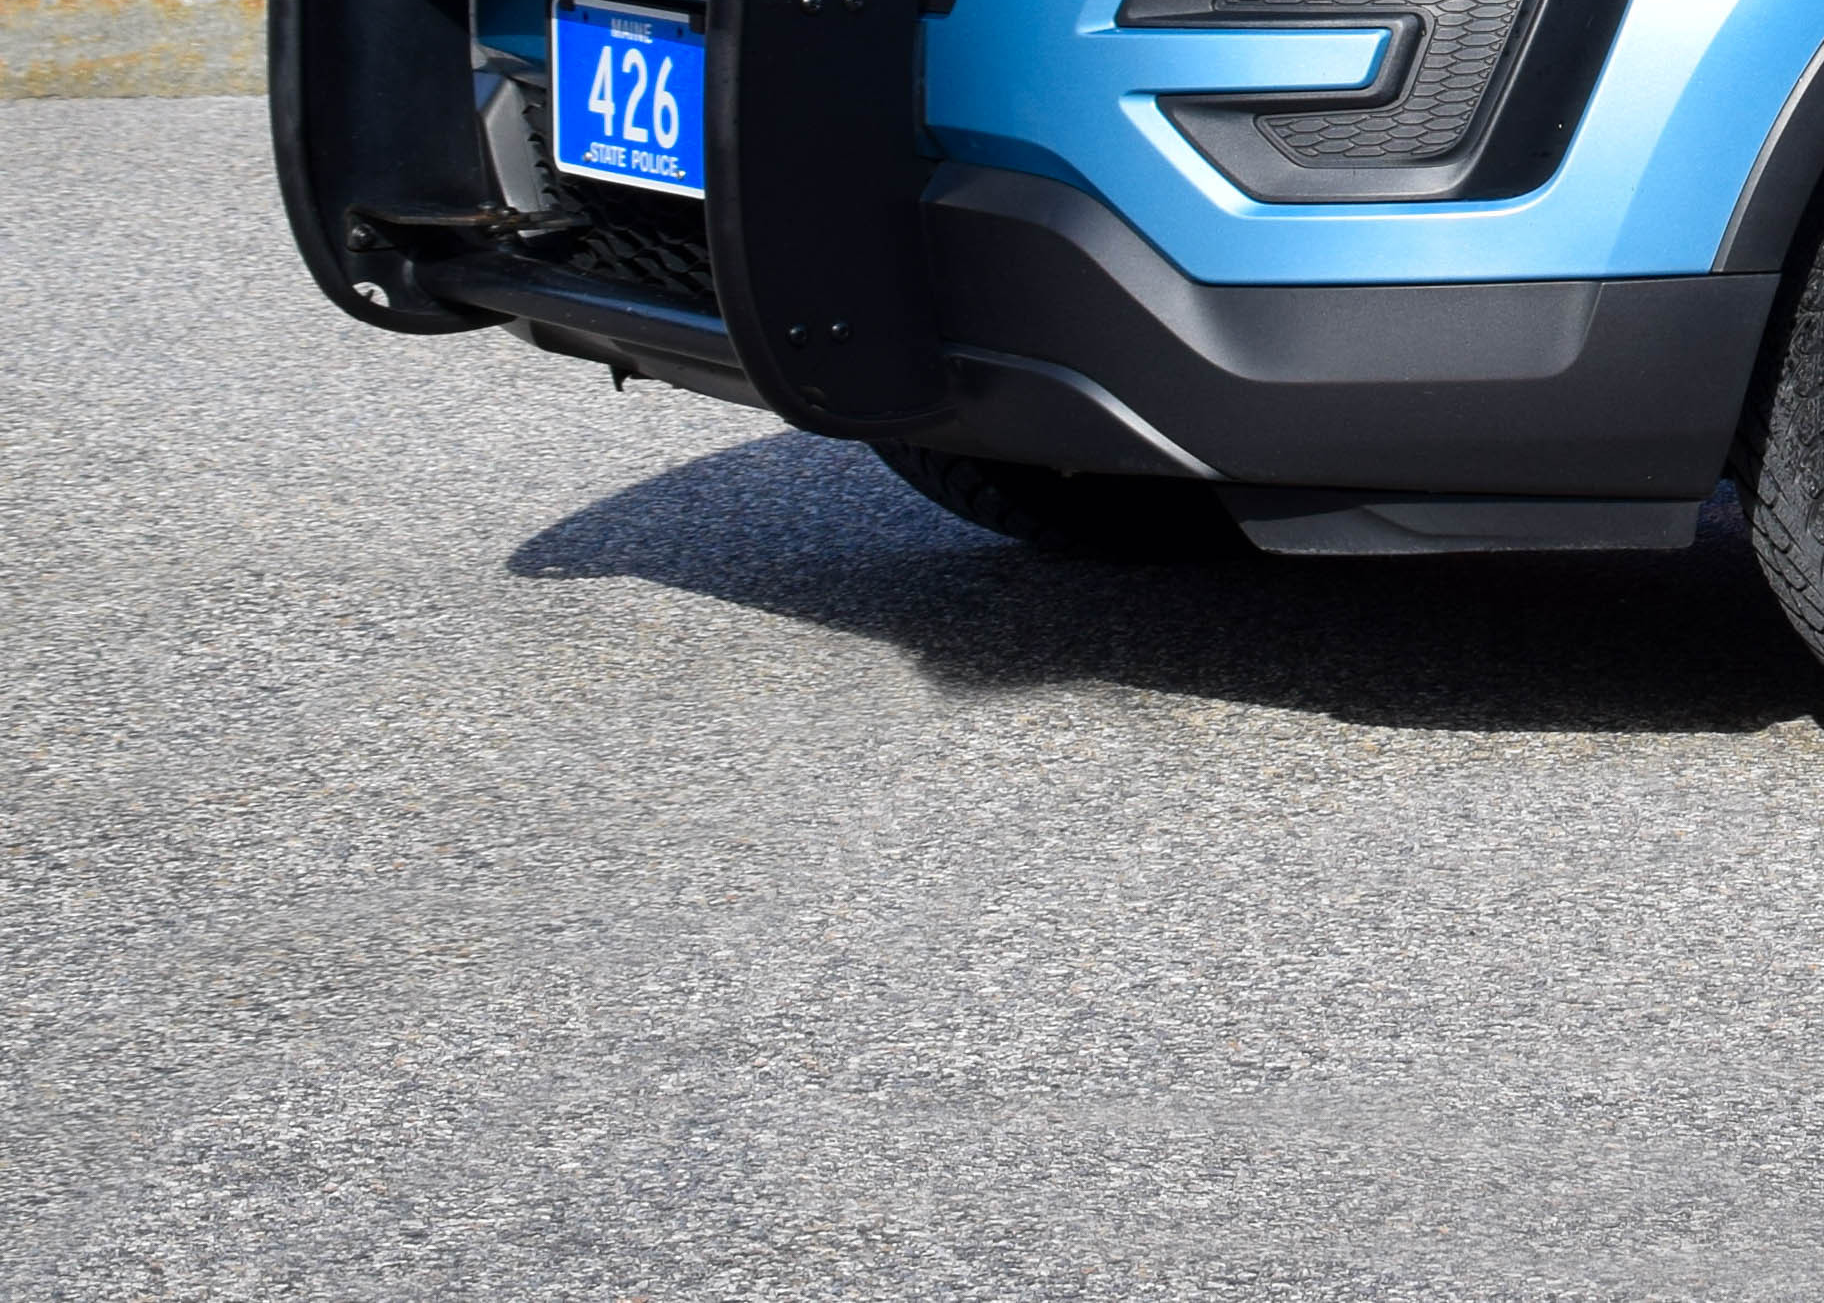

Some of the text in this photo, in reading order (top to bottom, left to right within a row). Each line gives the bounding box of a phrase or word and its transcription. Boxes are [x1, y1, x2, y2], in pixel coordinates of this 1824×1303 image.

[611, 18, 654, 44] MAINE
[588, 45, 680, 150] 426
[589, 142, 679, 178] STATE POLICE
